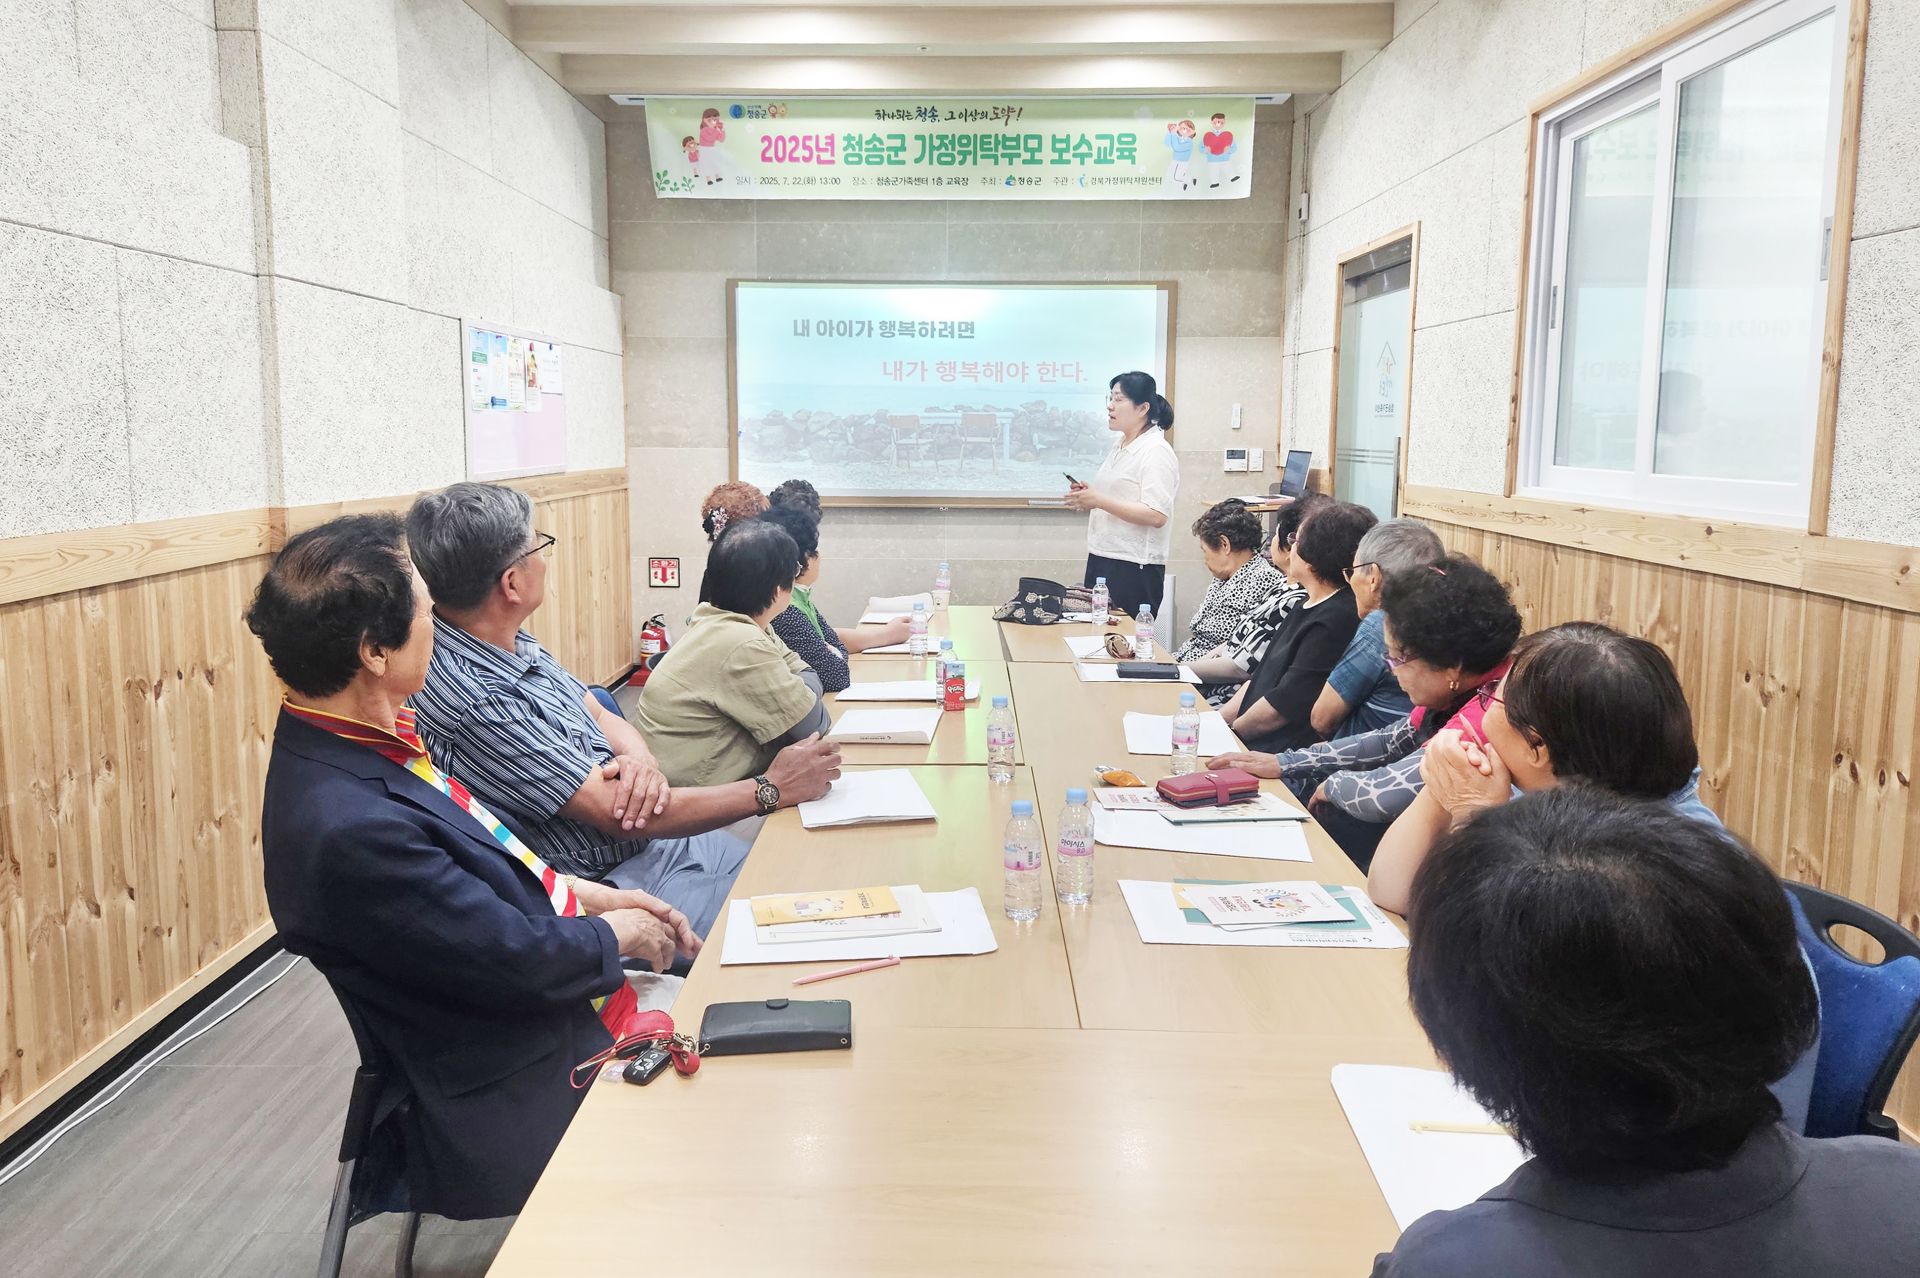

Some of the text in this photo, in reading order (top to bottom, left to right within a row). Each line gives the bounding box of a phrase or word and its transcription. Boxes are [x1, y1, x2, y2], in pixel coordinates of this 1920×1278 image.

[989, 105, 1024, 127] 도약!
[760, 132, 1138, 166] 2025년 청송군 가정위탁부모 보수교육
[819, 176, 841, 186] 13:00
[932, 176, 943, 186] 1층
[946, 176, 969, 186] 교육장
[1017, 176, 1042, 186] 청송군
[793, 319, 975, 340] 내 아이가 행복하려면
[882, 360, 1089, 384] 내가 행복해야 한다.
